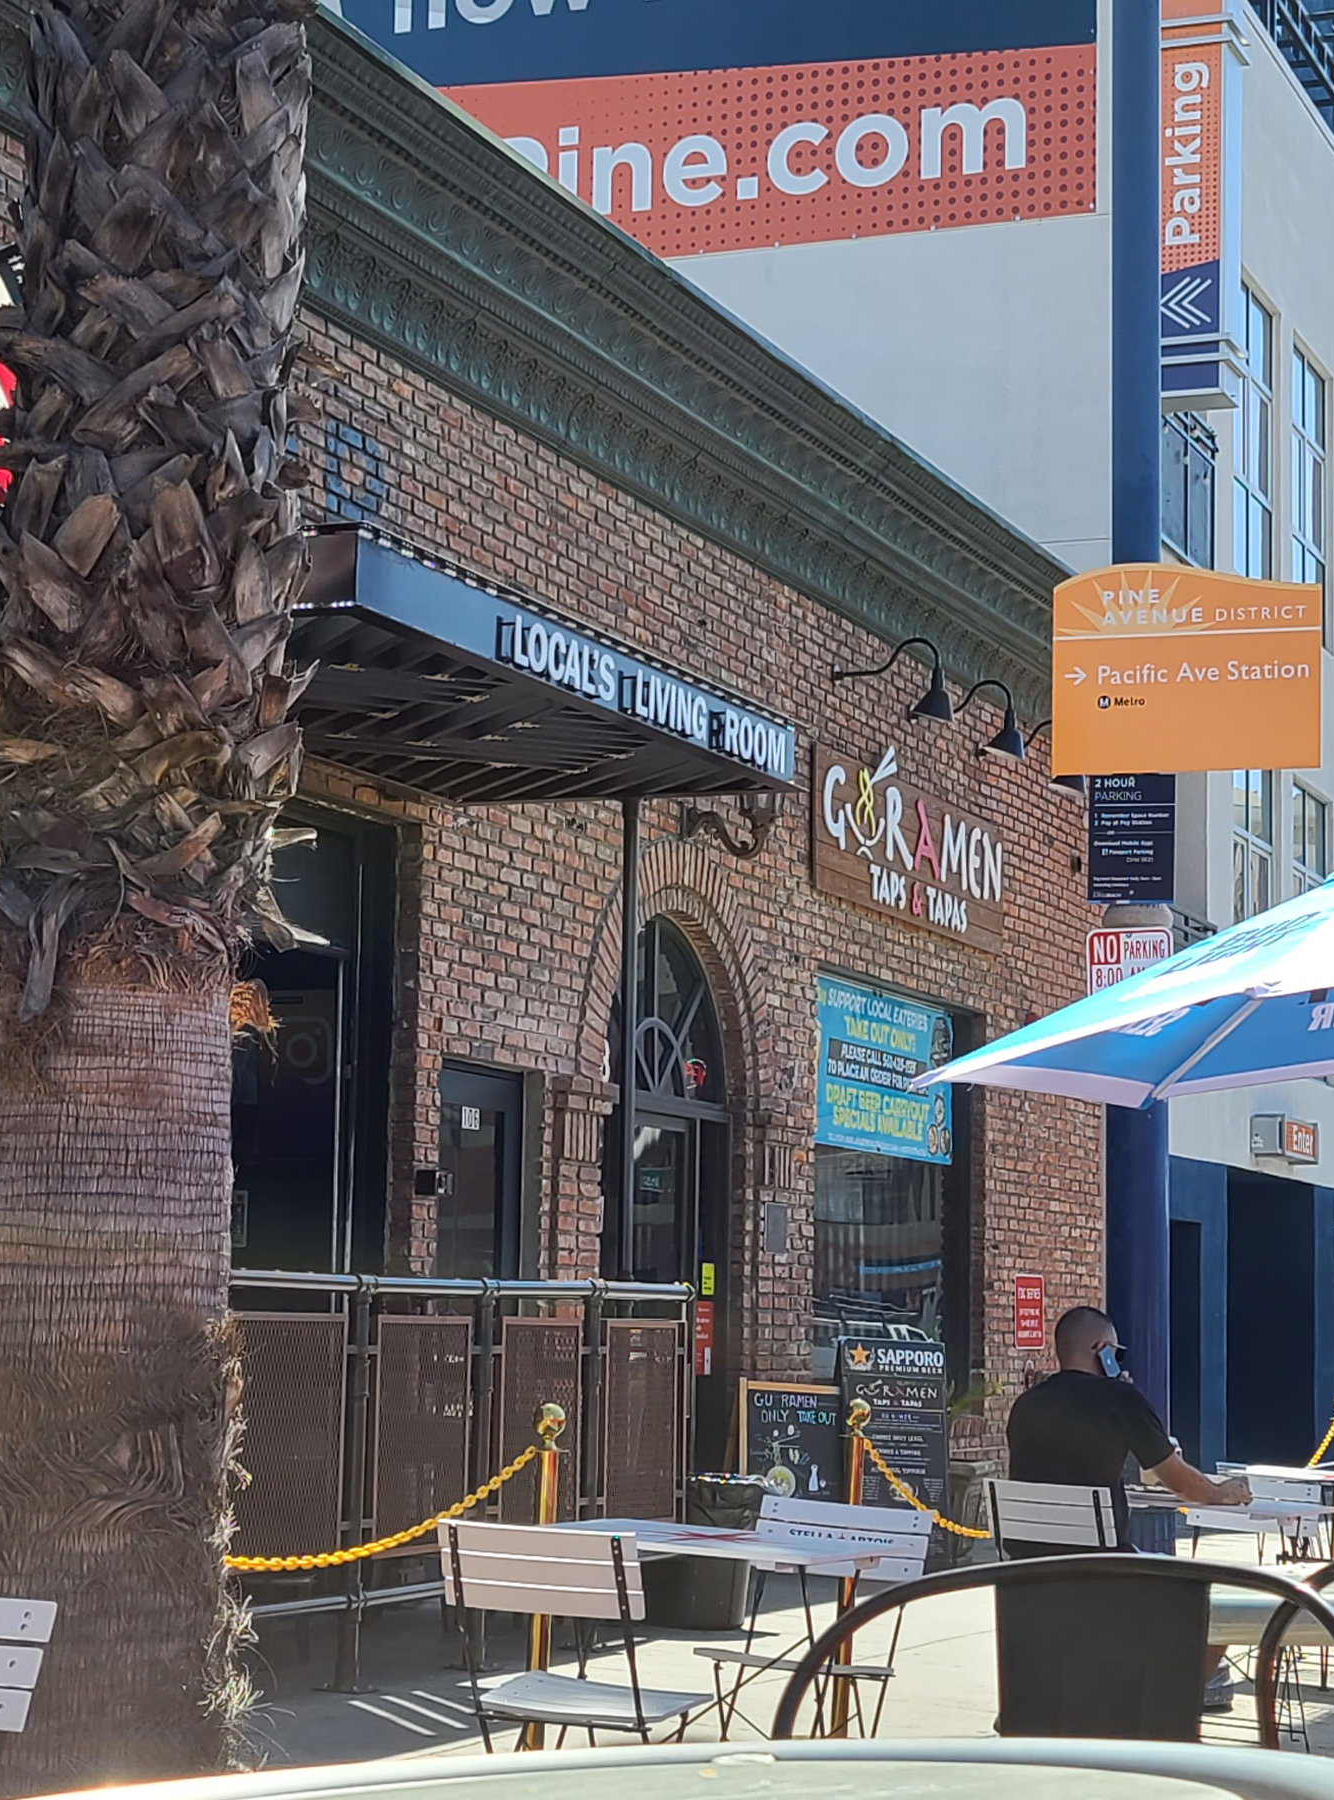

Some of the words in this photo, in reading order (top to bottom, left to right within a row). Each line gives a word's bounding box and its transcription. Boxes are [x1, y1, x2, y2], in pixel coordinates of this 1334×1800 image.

[1165, 62, 1210, 246] Parking
[1101, 588, 1160, 606] PINE
[1101, 607, 1204, 627] AVENUE
[1215, 604, 1307, 622] DISTRICT
[1097, 664, 1168, 685] Pacific
[1176, 662, 1220, 683] Ave
[1227, 660, 1310, 681] Station
[514, 614, 616, 702] LOCAL'S
[634, 668, 709, 742] LIVING
[724, 707, 787, 774] ROOM
[1114, 696, 1145, 707] Metro
[1094, 779, 1102, 788] 2
[1104, 777, 1135, 788] HOUR
[1094, 791, 1142, 801] PARKING
[870, 864, 907, 910] TAPS
[926, 885, 968, 934] TAPAS
[1093, 935, 1119, 964] NO
[1123, 938, 1165, 960] PARKING
[1096, 967, 1124, 987] 8:00
[828, 987, 867, 1015] SUPPORT
[867, 998, 893, 1022] LOCAL
[893, 1006, 928, 1033] EATERIES
[844, 1015, 869, 1040] TAKE
[870, 1021, 889, 1045] OUT
[841, 1043, 866, 1062] PLEASE
[867, 1048, 882, 1066] CALL
[828, 1058, 836, 1075] TO
[838, 1061, 859, 1079] PLACE
[826, 1083, 857, 1109] DRAFT
[858, 1090, 881, 1112] BEER
[833, 1106, 876, 1133] SPECIALS
[878, 1114, 924, 1142] AVAILABLE
[1292, 1123, 1314, 1156] Enter
[877, 1348, 944, 1367] SAPPORO
[879, 1364, 920, 1373] PREMIUM
[921, 1366, 943, 1374] BEER
[754, 1392, 773, 1408] GU
[781, 1394, 817, 1410] RAMEN
[761, 1408, 790, 1424] ONLY
[817, 1413, 837, 1427] OUT
